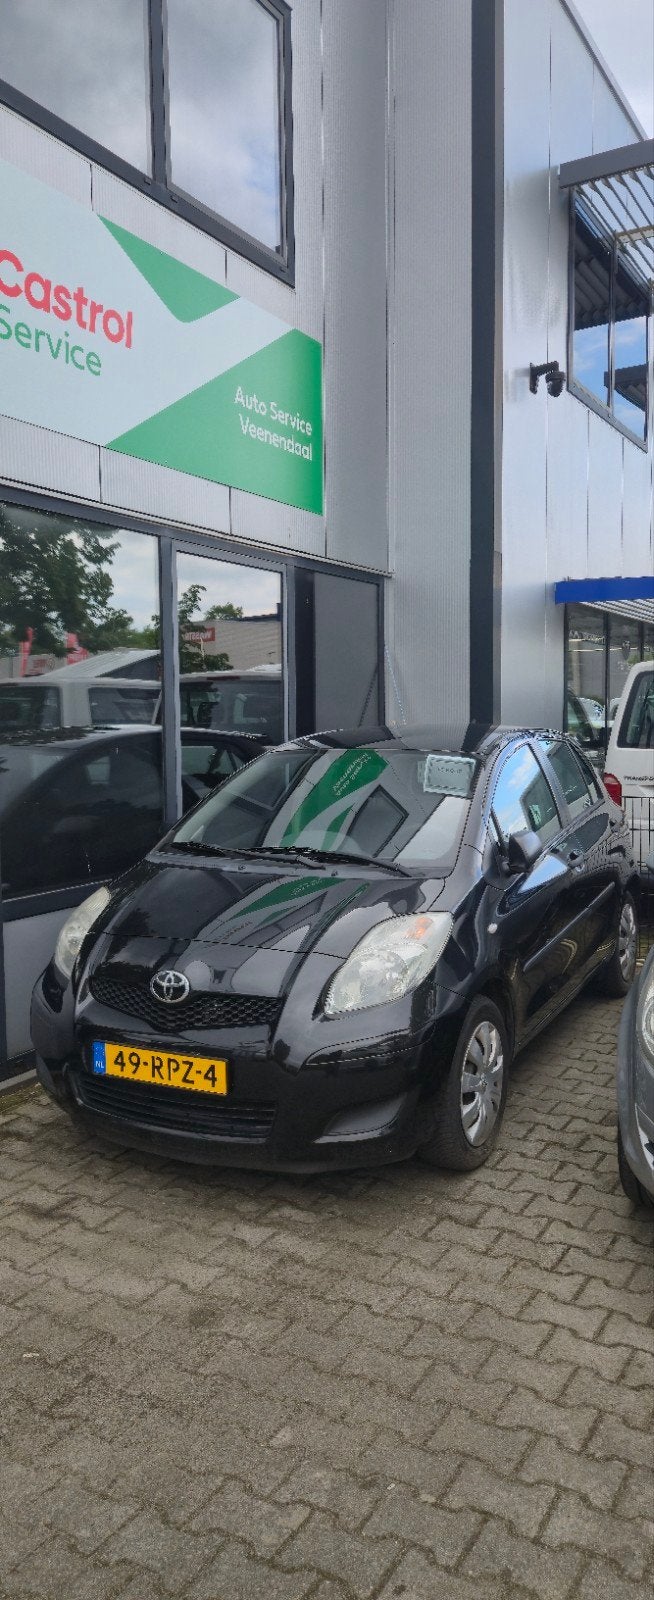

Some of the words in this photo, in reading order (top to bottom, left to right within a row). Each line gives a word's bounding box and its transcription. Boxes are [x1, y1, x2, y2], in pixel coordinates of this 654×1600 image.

[0, 249, 133, 349] Castrol
[0, 303, 102, 376] Service
[234, 386, 267, 415] Auto
[270, 401, 312, 436] Service
[239, 413, 312, 461] Veenendaal
[95, 1060, 105, 1069] NL
[113, 1050, 218, 1088] 49-RPZ-4
